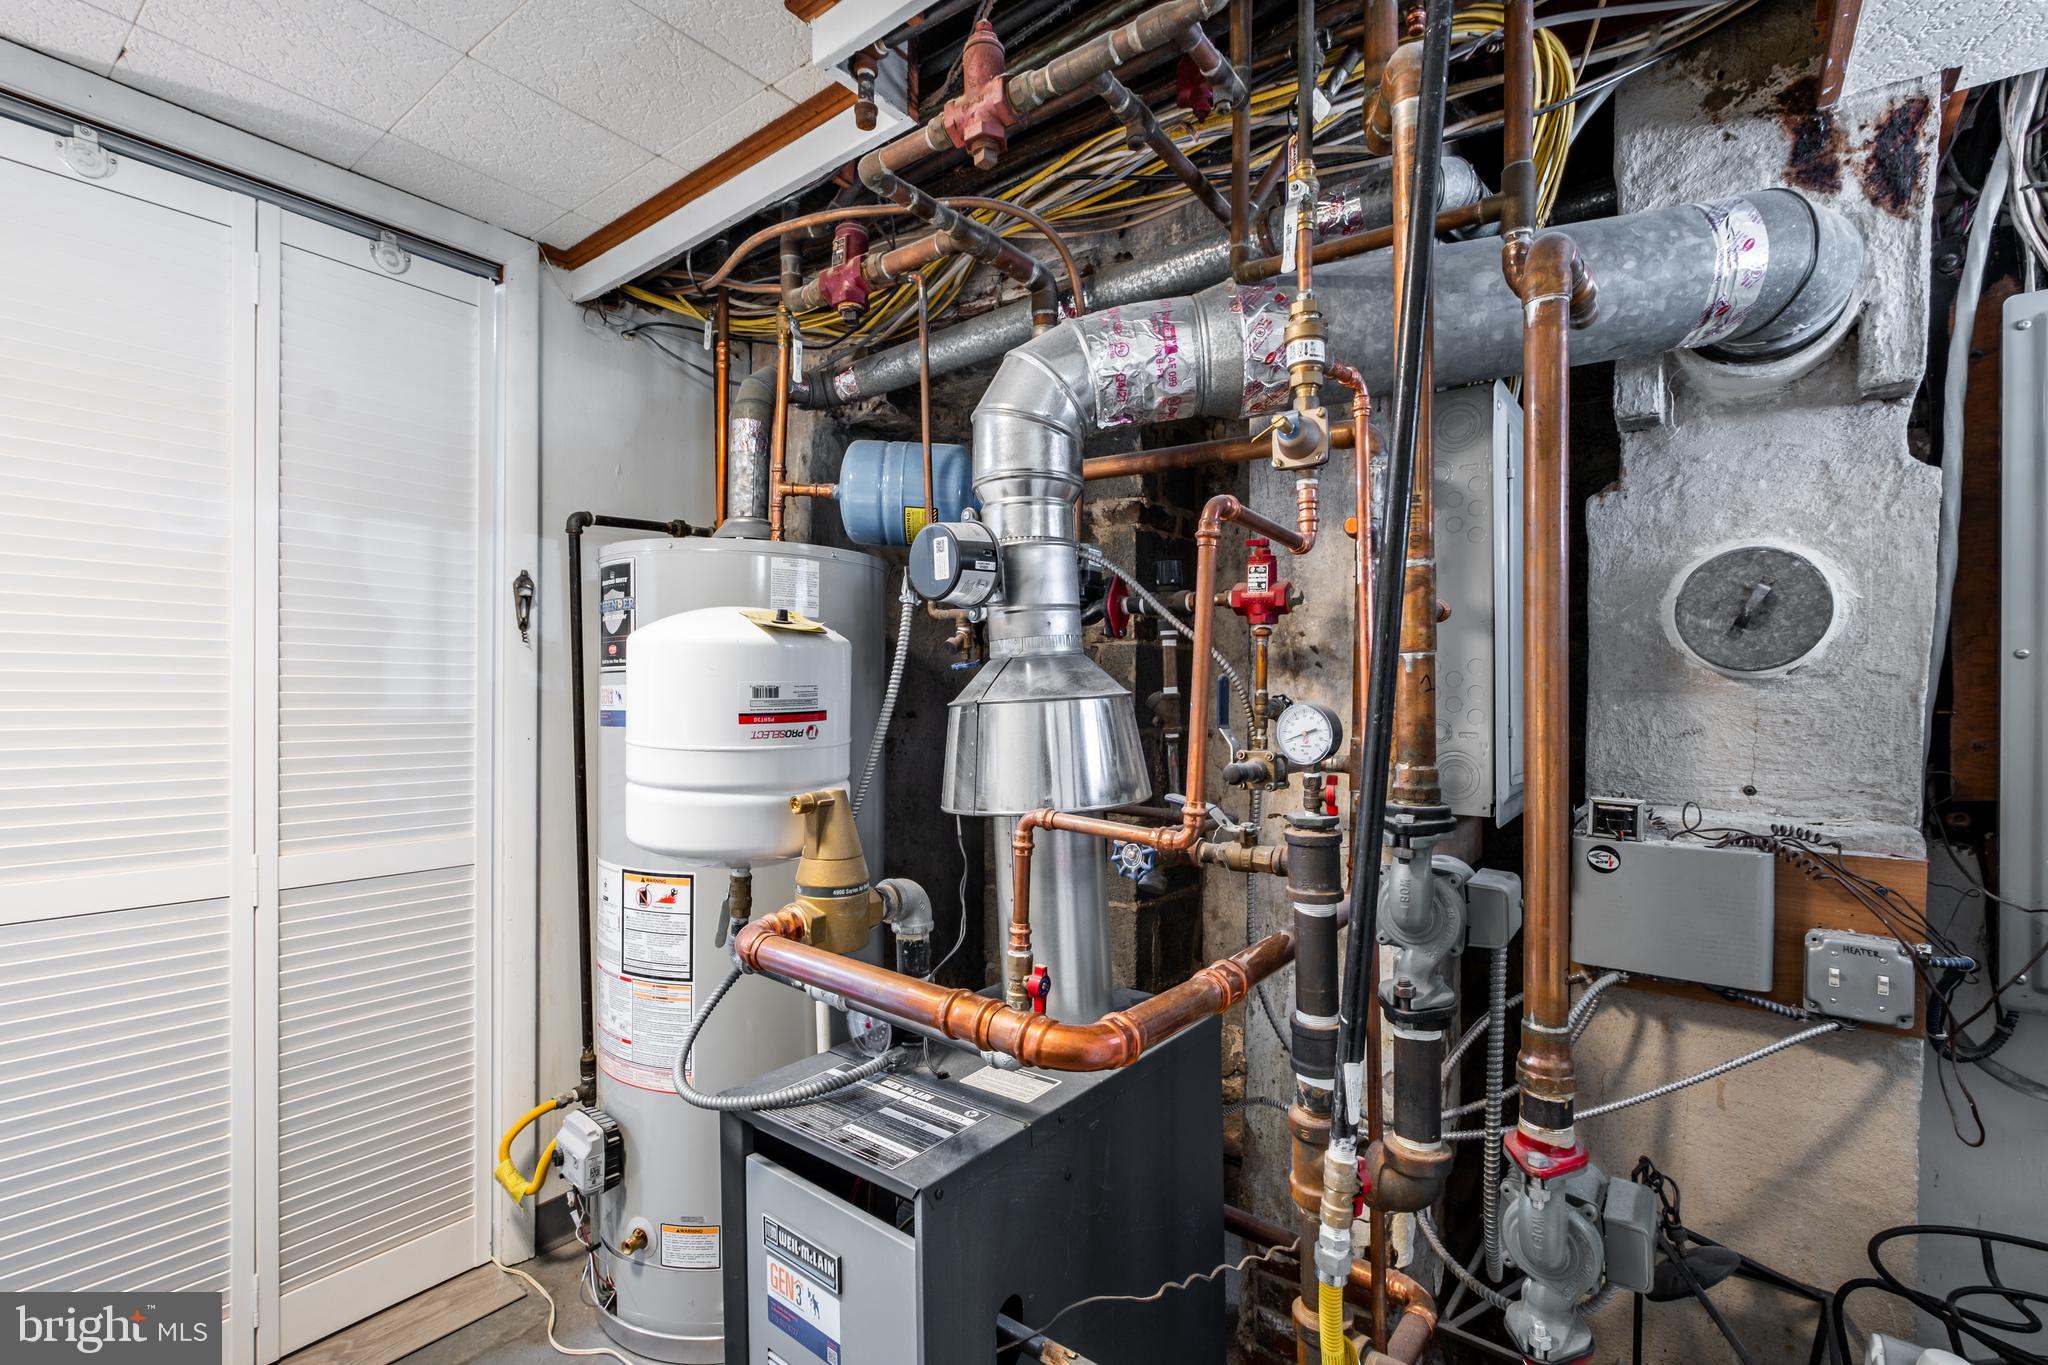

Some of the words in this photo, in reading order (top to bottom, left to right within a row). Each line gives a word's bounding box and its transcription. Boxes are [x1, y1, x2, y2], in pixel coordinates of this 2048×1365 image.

[1168, 371, 1178, 387] 099
[752, 729, 804, 740] PROSELECT
[1842, 945, 1881, 958] HEATER
[901, 1116, 928, 1128] NOTICE
